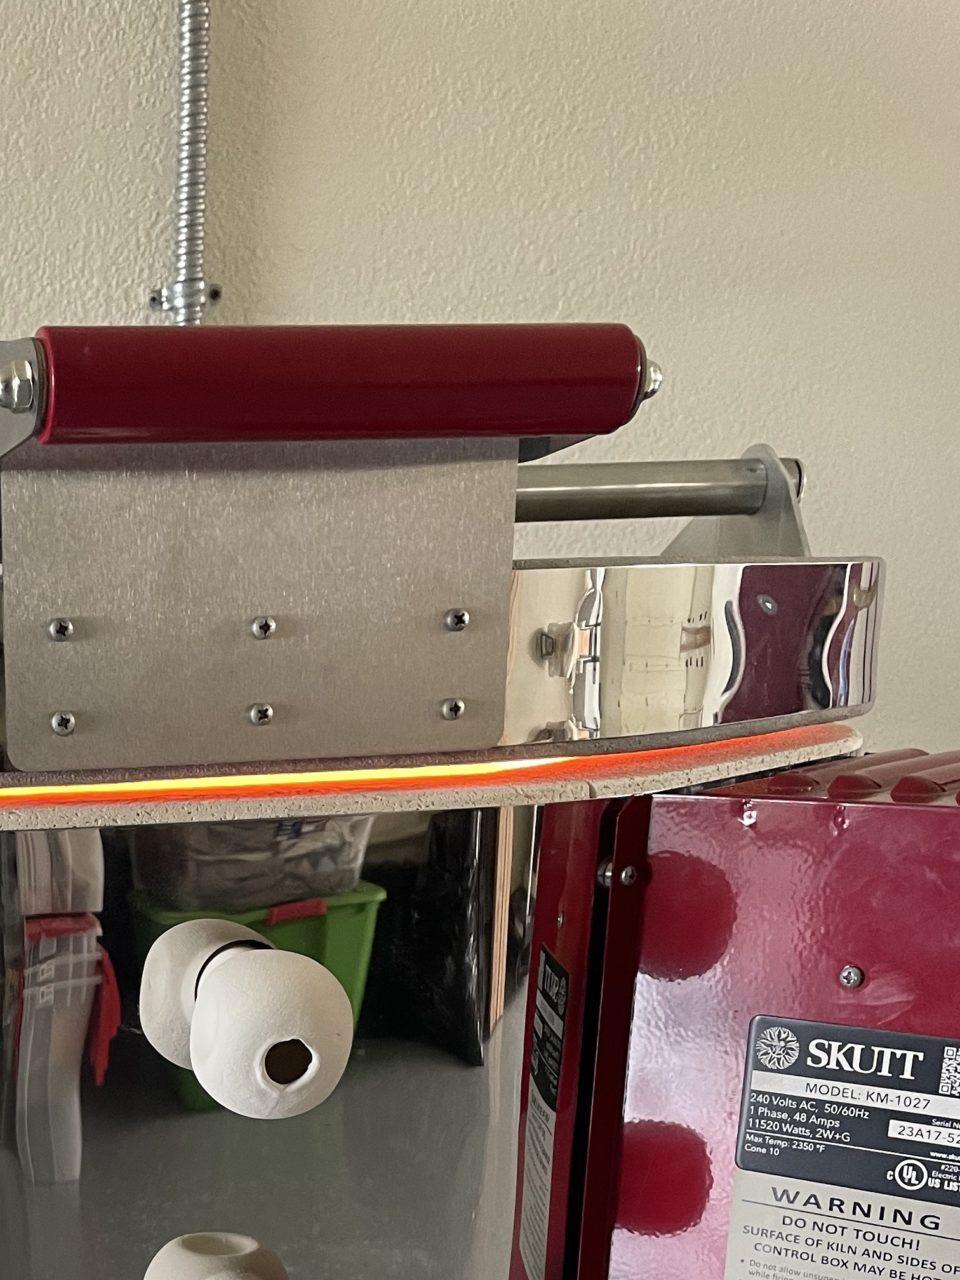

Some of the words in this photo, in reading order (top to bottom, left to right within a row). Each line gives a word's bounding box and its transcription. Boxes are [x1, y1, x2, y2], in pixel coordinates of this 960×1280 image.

[806, 1038, 925, 1080] SKUTT
[750, 1092, 770, 1104] 240
[772, 1095, 797, 1109] Volts
[799, 1100, 818, 1112] AC,
[824, 1103, 870, 1120] 50/60Hz
[805, 1082, 861, 1100] MODEL:
[866, 1090, 931, 1110] KM-1027
[748, 1117, 780, 1131] 11520
[782, 1122, 813, 1138] Watts,
[816, 1128, 851, 1143] 2W+G
[750, 1105, 754, 1115] 1
[758, 1106, 790, 1121] Phase,
[793, 1112, 807, 1123] 48
[808, 1115, 840, 1129] Amps
[931, 1118, 951, 1128] Serial
[744, 1143, 767, 1154] Cone
[769, 1147, 780, 1156] 10
[745, 1133, 763, 1143] Max
[765, 1136, 790, 1148] Temp:
[792, 1140, 814, 1151] 2350
[902, 1165, 919, 1185] UL
[927, 1177, 941, 1189] US
[771, 1186, 941, 1231] WARNING
[782, 1215, 807, 1229] DO
[812, 1221, 848, 1237] NOT
[853, 1228, 921, 1251] TOUCH!
[742, 1225, 801, 1245] SURFACE
[805, 1236, 823, 1248] OF
[826, 1241, 857, 1256] KILN
[861, 1248, 893, 1262] AND
[896, 1255, 937, 1271] SIDES
[754, 1242, 816, 1263] CONTROL
[821, 1255, 849, 1269] BOX
[853, 1262, 886, 1277] MAY
[889, 1269, 907, 1280] BE
[748, 1269, 770, 1279] while
[749, 1259, 761, 1268] Do
[763, 1263, 777, 1271] not
[779, 1266, 801, 1276] allow
